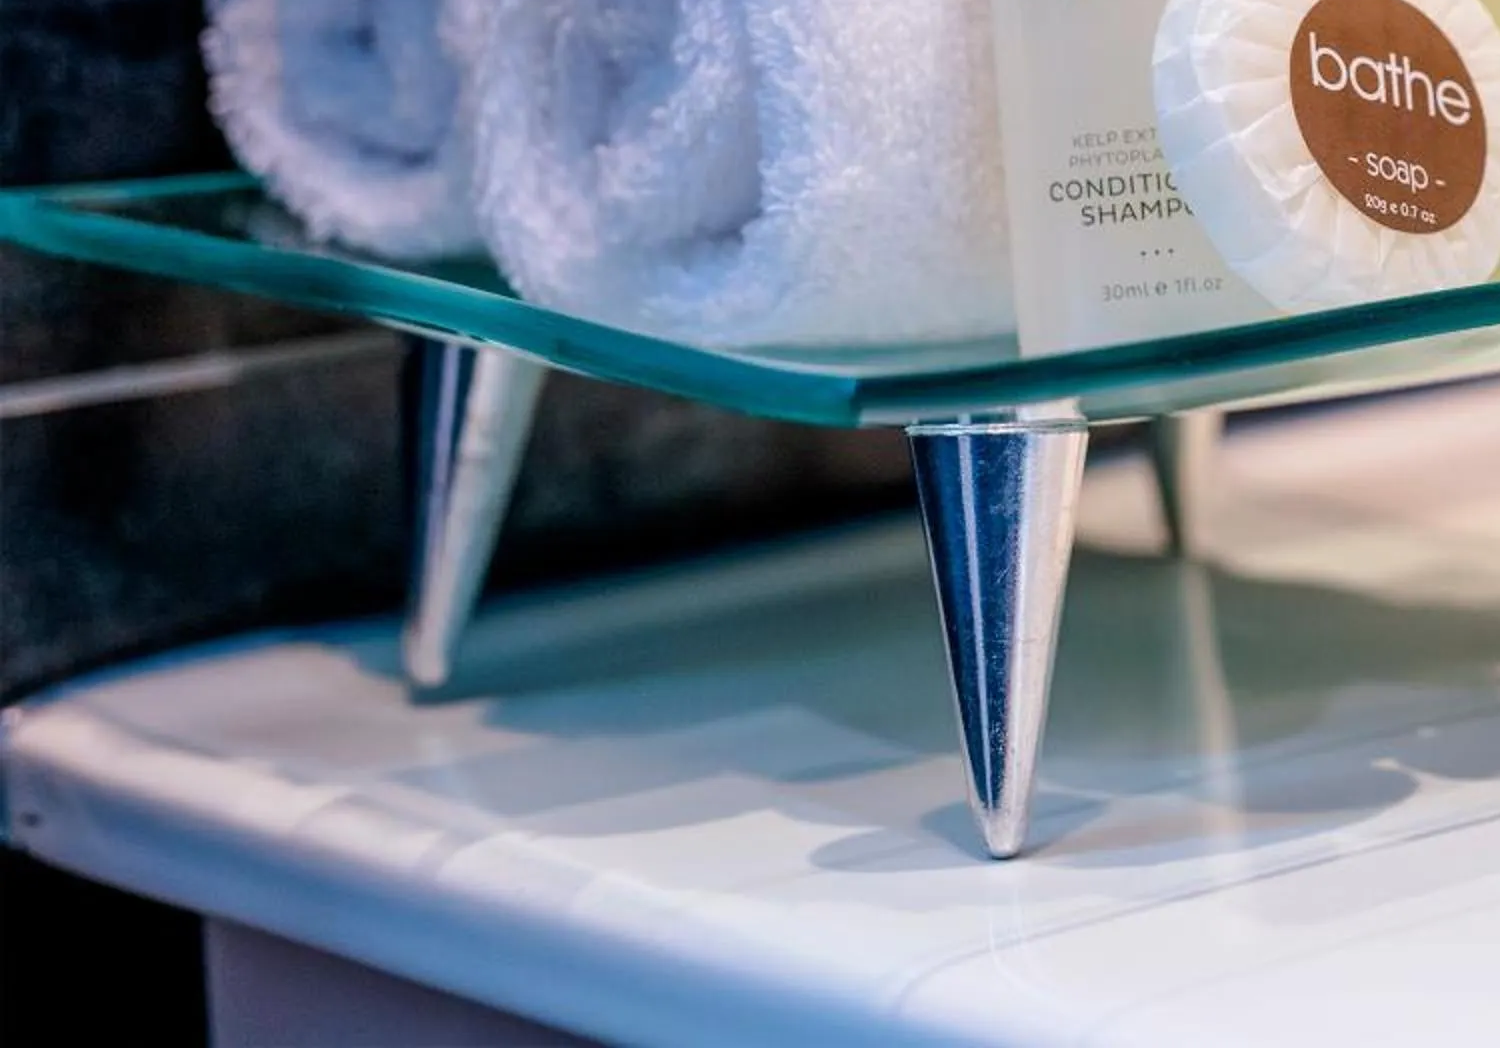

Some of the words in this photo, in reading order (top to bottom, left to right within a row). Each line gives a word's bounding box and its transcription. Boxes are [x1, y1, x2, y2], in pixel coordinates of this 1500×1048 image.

[1309, 31, 1472, 127] bathe
[1072, 129, 1118, 148] KELP
[1365, 152, 1429, 194] soap
[1102, 281, 1150, 302] 30ml
